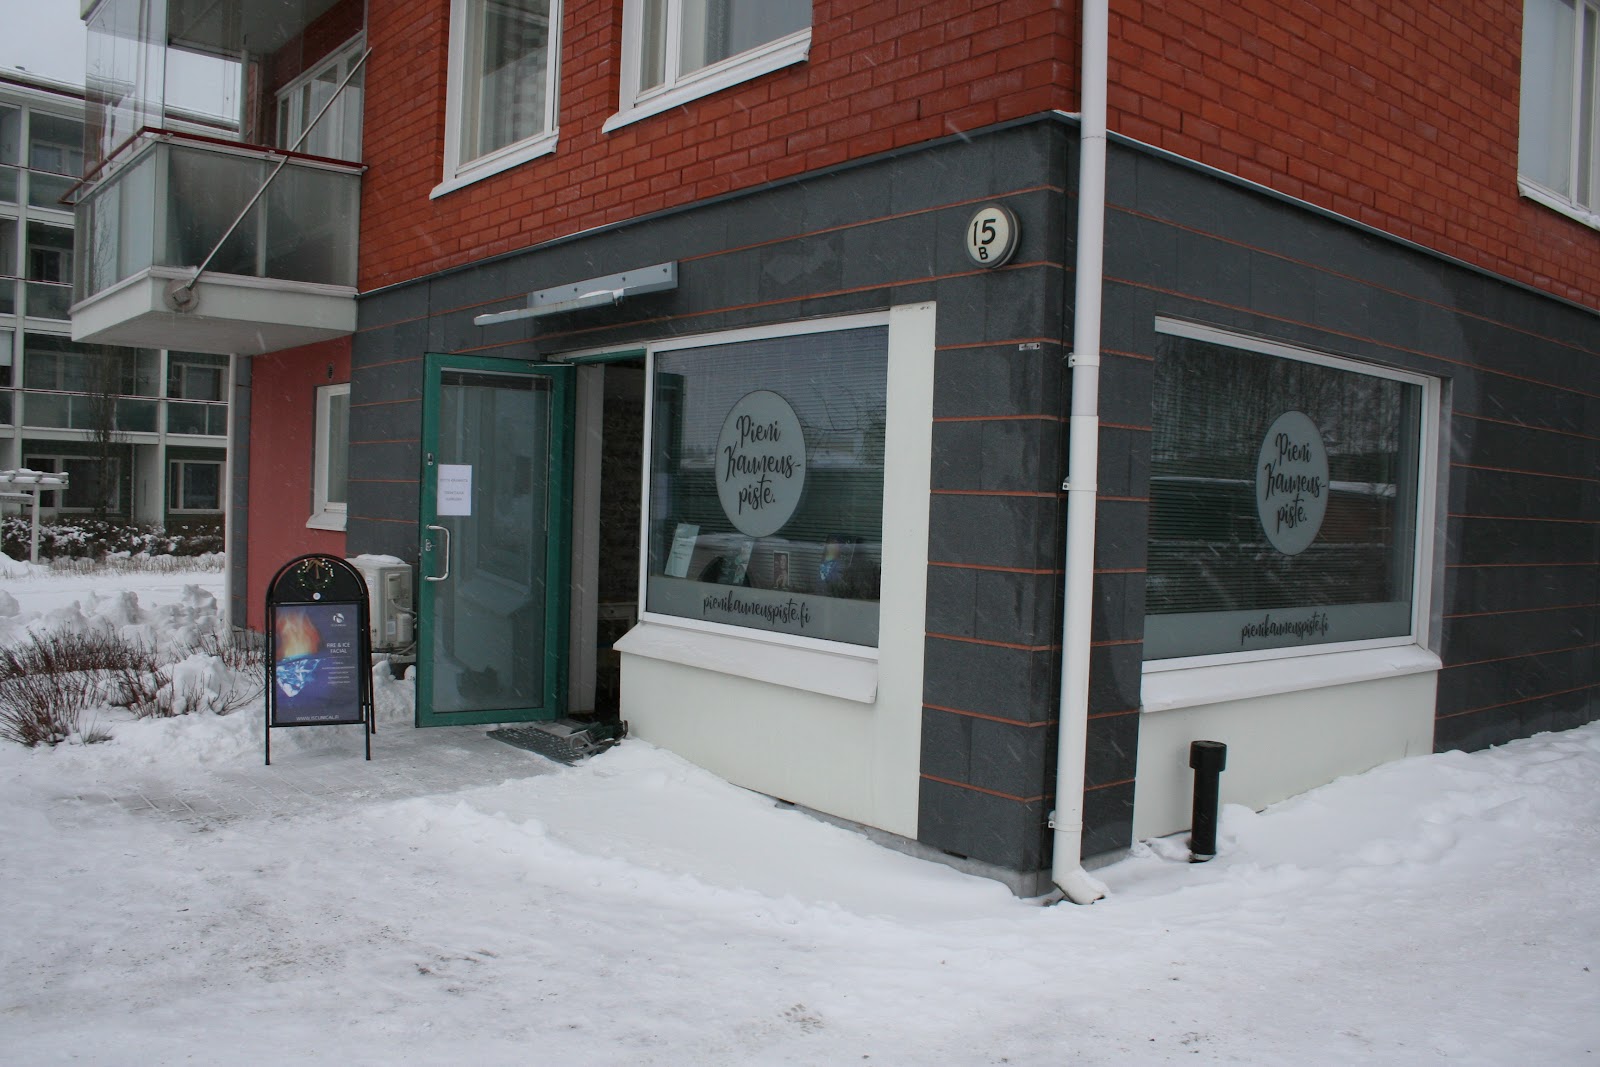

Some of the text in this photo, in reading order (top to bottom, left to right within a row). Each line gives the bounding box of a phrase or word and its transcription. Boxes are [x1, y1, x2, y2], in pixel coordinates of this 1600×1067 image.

[973, 218, 997, 247] 15
[978, 246, 989, 260] B
[736, 414, 782, 449] Pieni
[1275, 432, 1312, 467] Pieni
[723, 440, 801, 483] Kauneus-
[1264, 458, 1327, 501] Kauneus-
[738, 473, 776, 515] piste.
[1276, 492, 1308, 535] piste.
[703, 590, 811, 628] pienikauneuspiste.fi
[1240, 610, 1329, 646] pienikauneuspiste.fi
